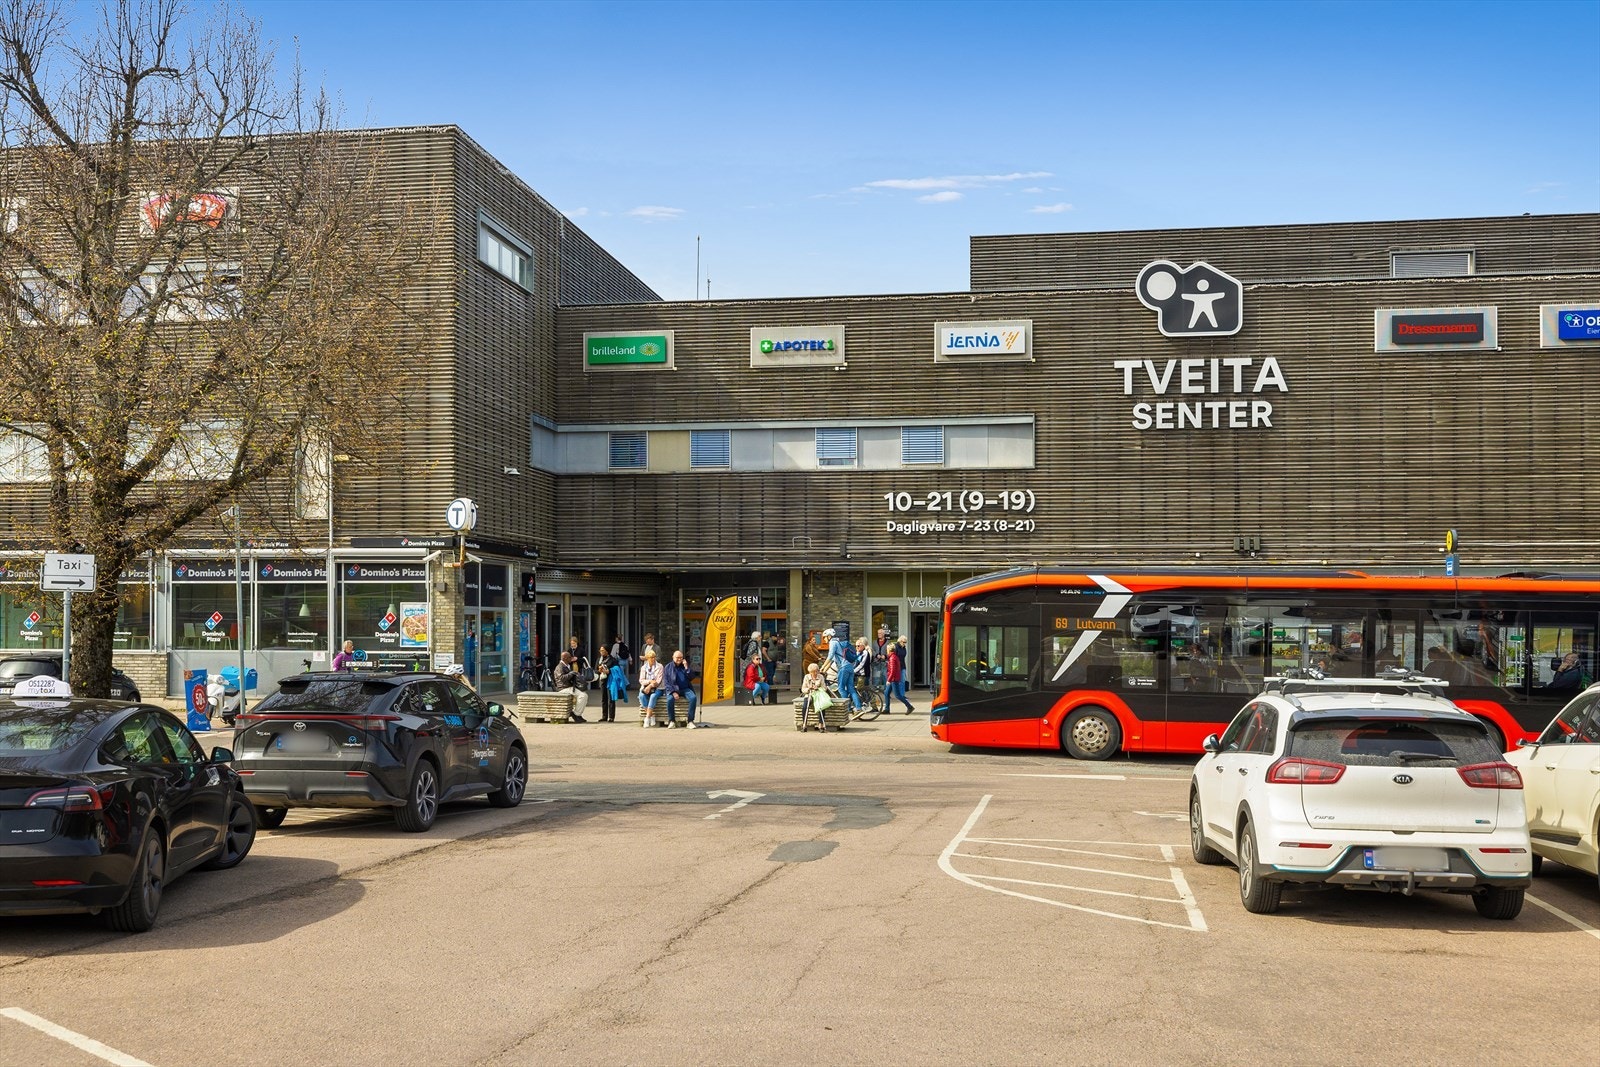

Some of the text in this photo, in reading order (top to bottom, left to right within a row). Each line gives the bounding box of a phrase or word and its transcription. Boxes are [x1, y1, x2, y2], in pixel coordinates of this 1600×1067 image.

[1397, 323, 1478, 335] Dressmann
[592, 345, 636, 356] brilleland
[773, 339, 835, 352] APOTEK 1
[1113, 356, 1289, 396] TVEITA
[1131, 400, 1274, 430] SENTER
[451, 507, 463, 526] T
[886, 520, 956, 535] Dagligvare
[57, 559, 82, 570] Taxi
[187, 568, 250, 577] Domino's Piza
[273, 568, 312, 577] Domino's
[360, 567, 426, 577] Domino's Pizza
[714, 615, 734, 623] BKH
[1055, 617, 1117, 630] 69 Lutvann
[719, 632, 727, 656] BISLETT
[28, 680, 56, 688] OS12287
[27, 687, 56, 695] mytaxi
[1395, 775, 1411, 784] KIA
